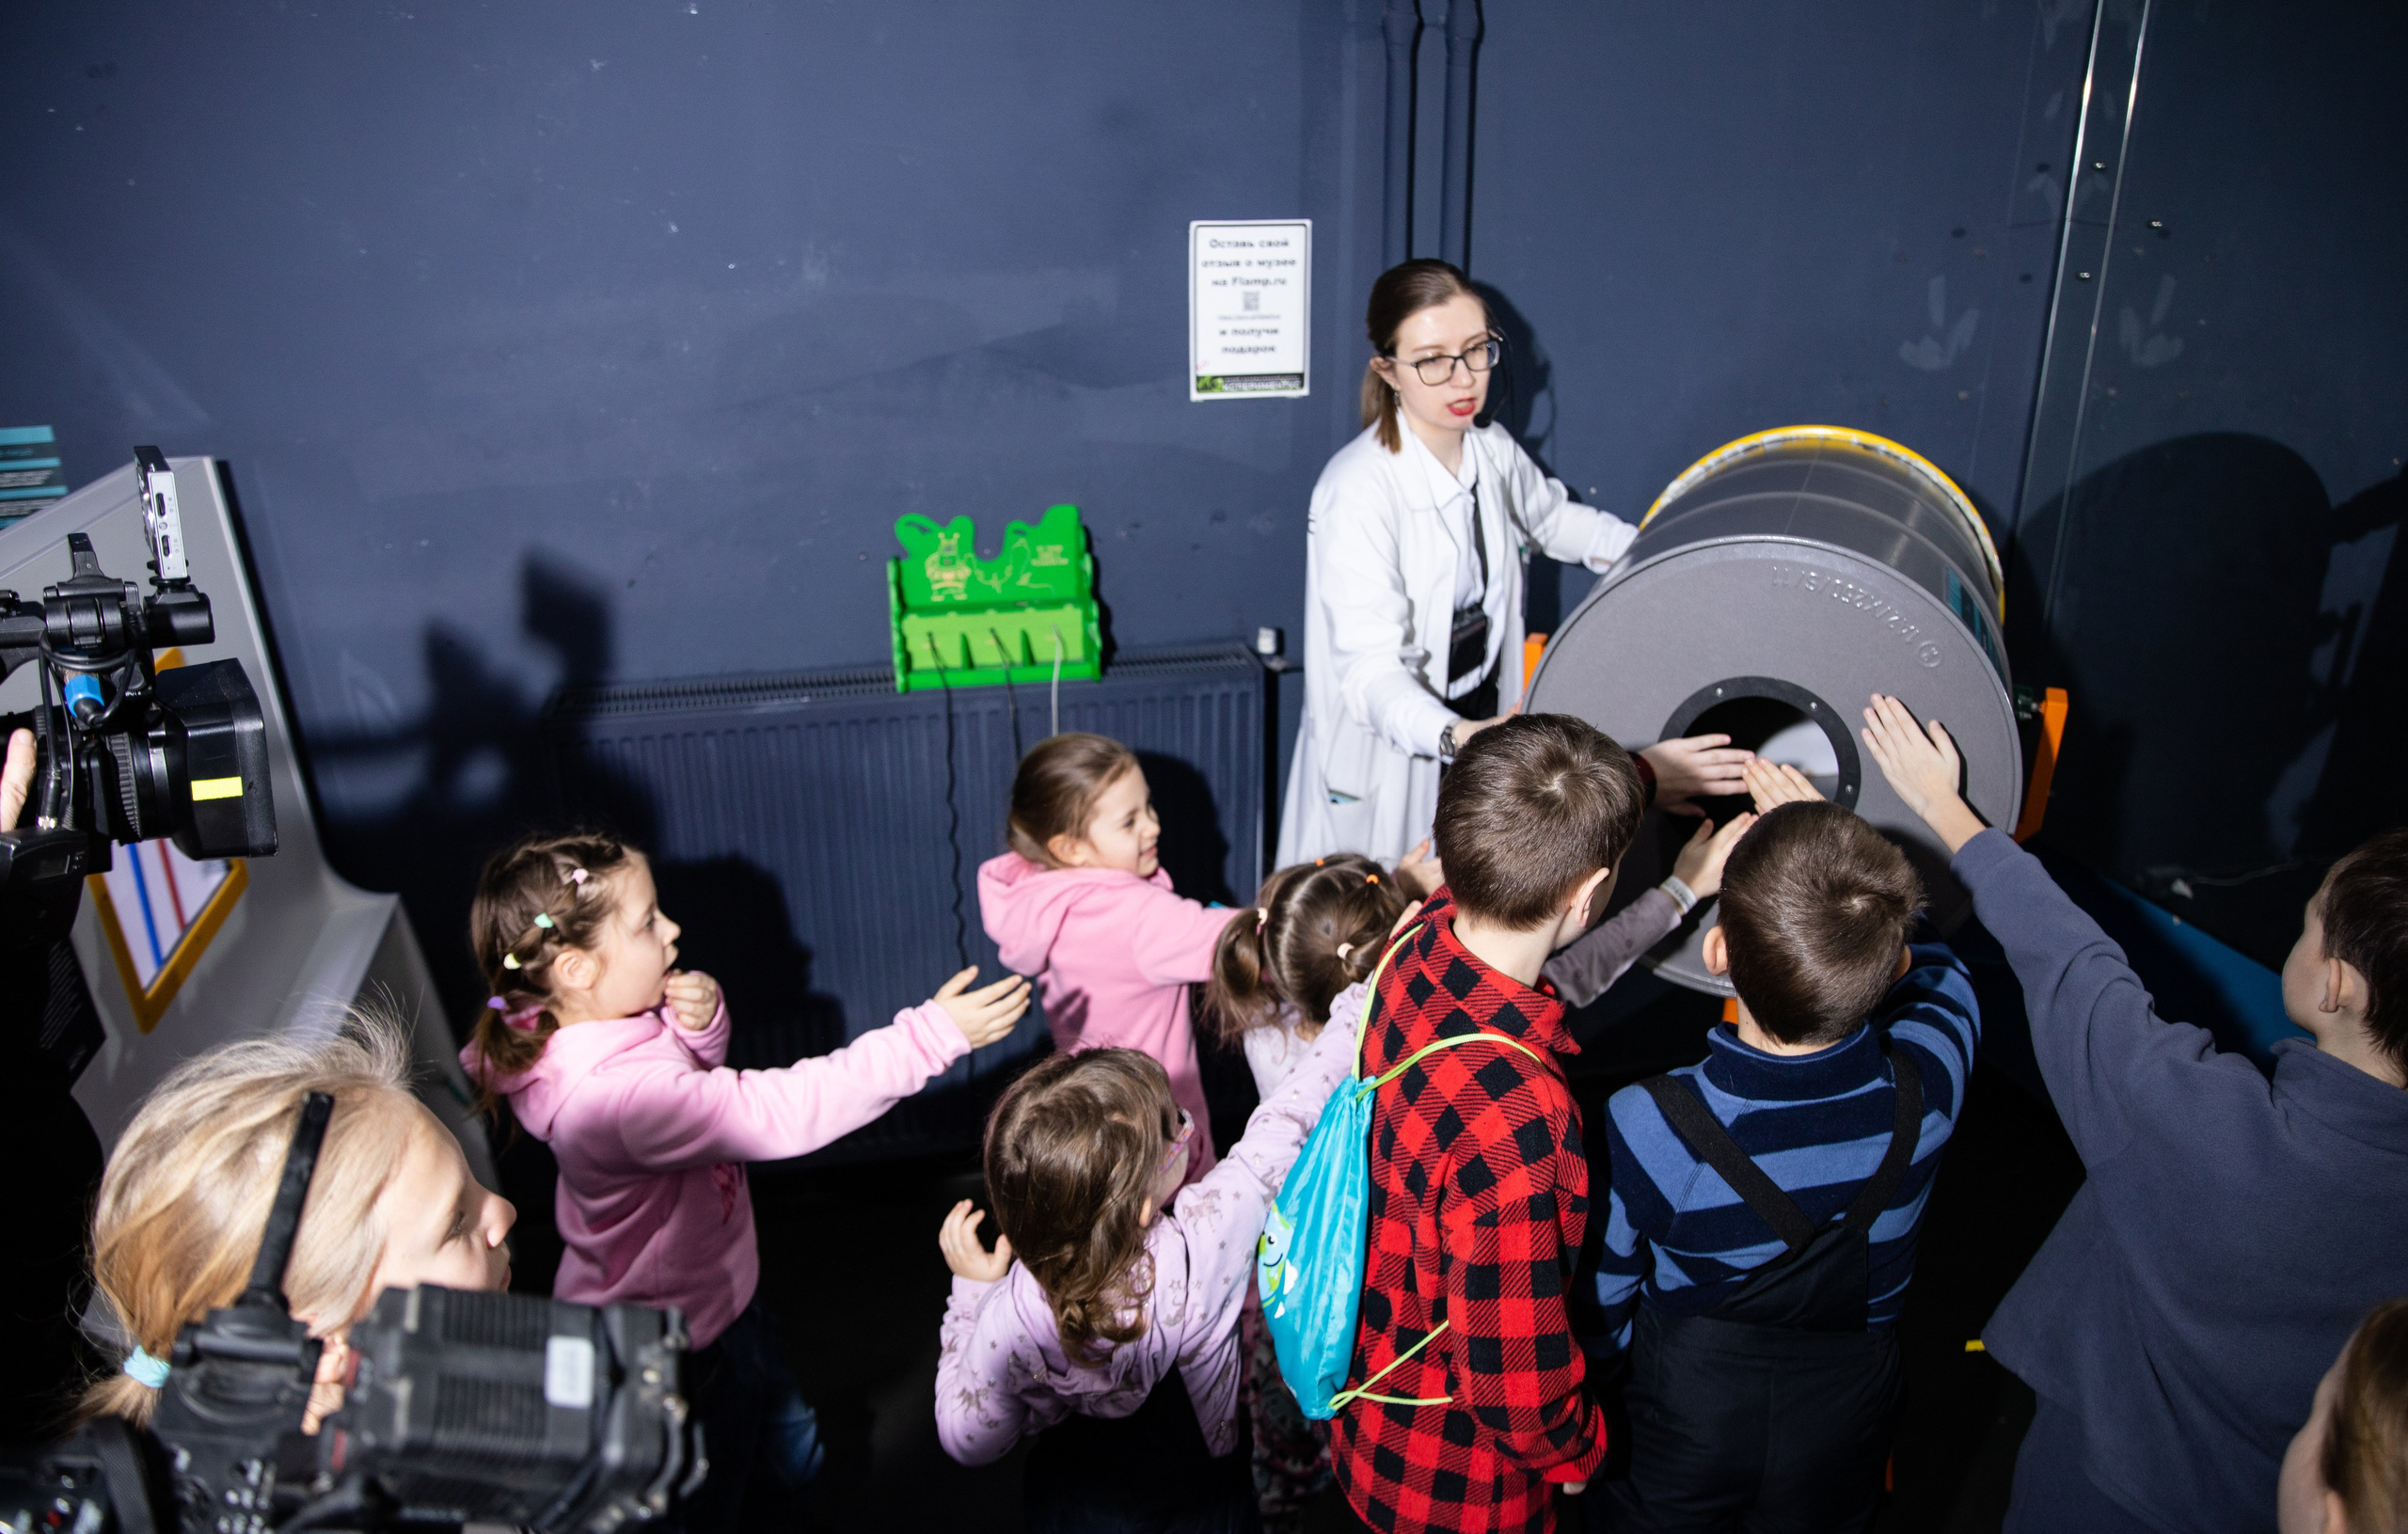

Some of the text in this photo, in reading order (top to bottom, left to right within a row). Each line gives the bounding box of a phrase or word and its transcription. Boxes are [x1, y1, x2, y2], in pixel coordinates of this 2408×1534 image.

[1209, 237, 1289, 248] Оставь свой
[1201, 260, 1241, 268] отзыв
[1258, 259, 1296, 269] музее
[1231, 277, 1287, 287] Flamp.ru
[1231, 327, 1278, 338] получи
[1222, 345, 1275, 354] подарок
